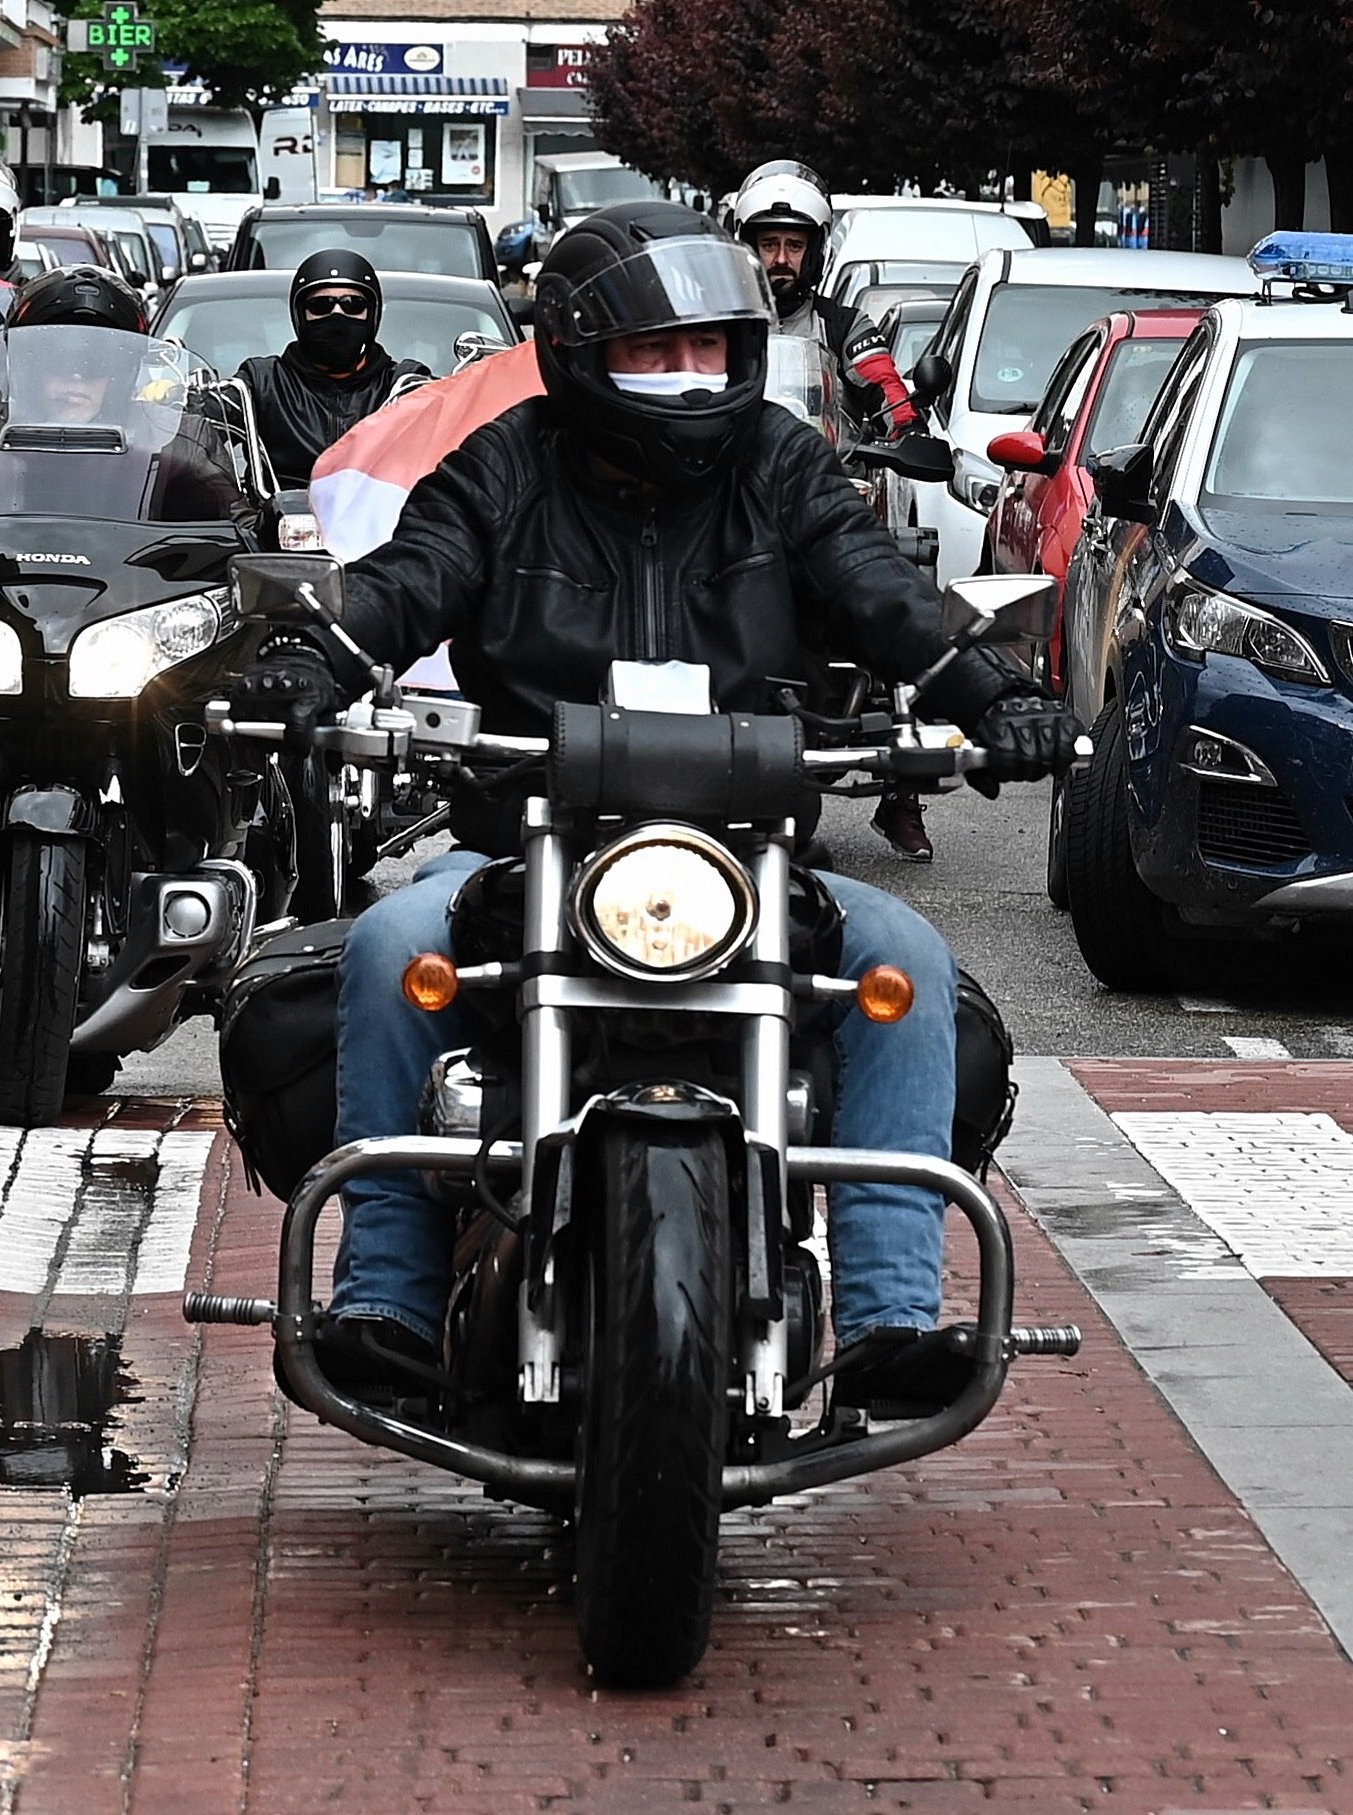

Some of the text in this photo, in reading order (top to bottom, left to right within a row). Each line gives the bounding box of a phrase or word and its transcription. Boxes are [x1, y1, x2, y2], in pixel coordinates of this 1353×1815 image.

[89, 25, 151, 45] BIER
[323, 45, 383, 72] AS ARES
[423, 101, 464, 113] BASES
[16, 553, 91, 565] HONDA
